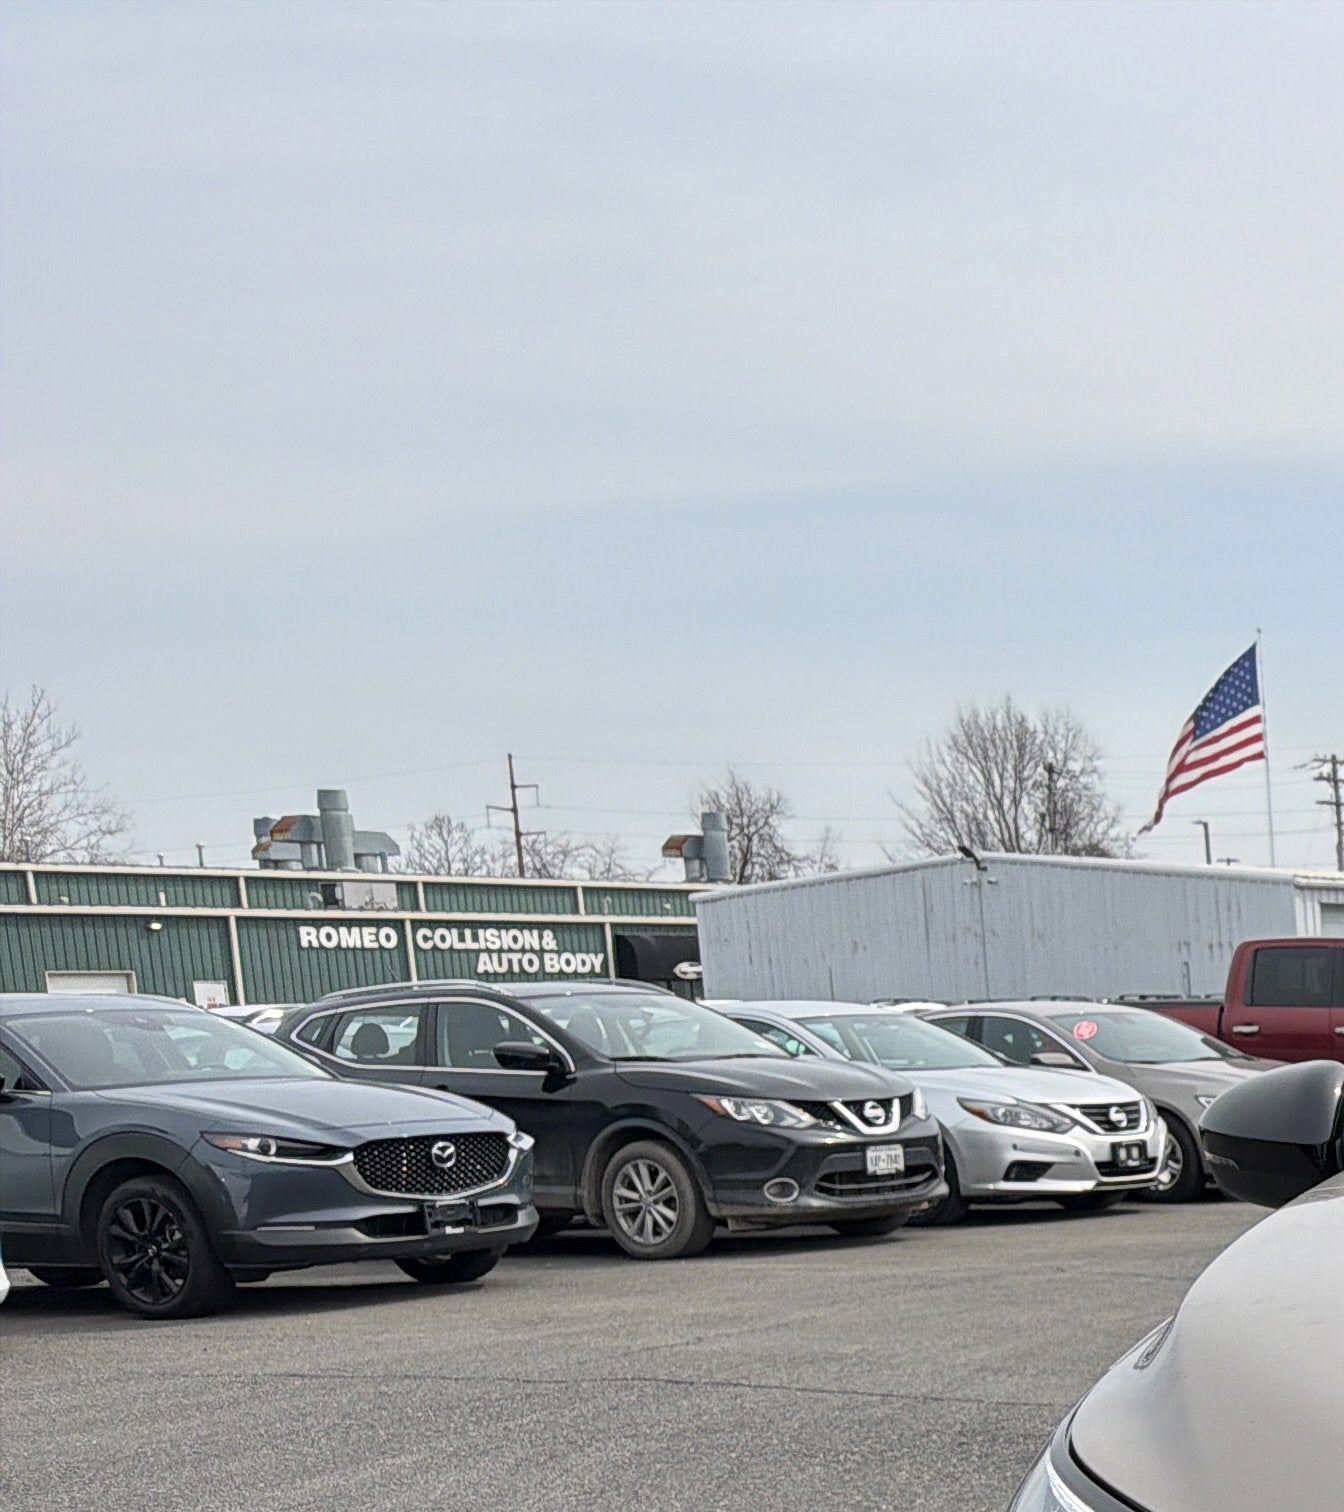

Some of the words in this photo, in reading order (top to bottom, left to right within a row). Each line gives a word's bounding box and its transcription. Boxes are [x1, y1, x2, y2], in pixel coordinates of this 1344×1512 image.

[299, 926, 398, 949] ROMEO
[416, 928, 540, 950] COLLISION
[476, 952, 540, 974] AUTO
[544, 953, 605, 974] BODY
